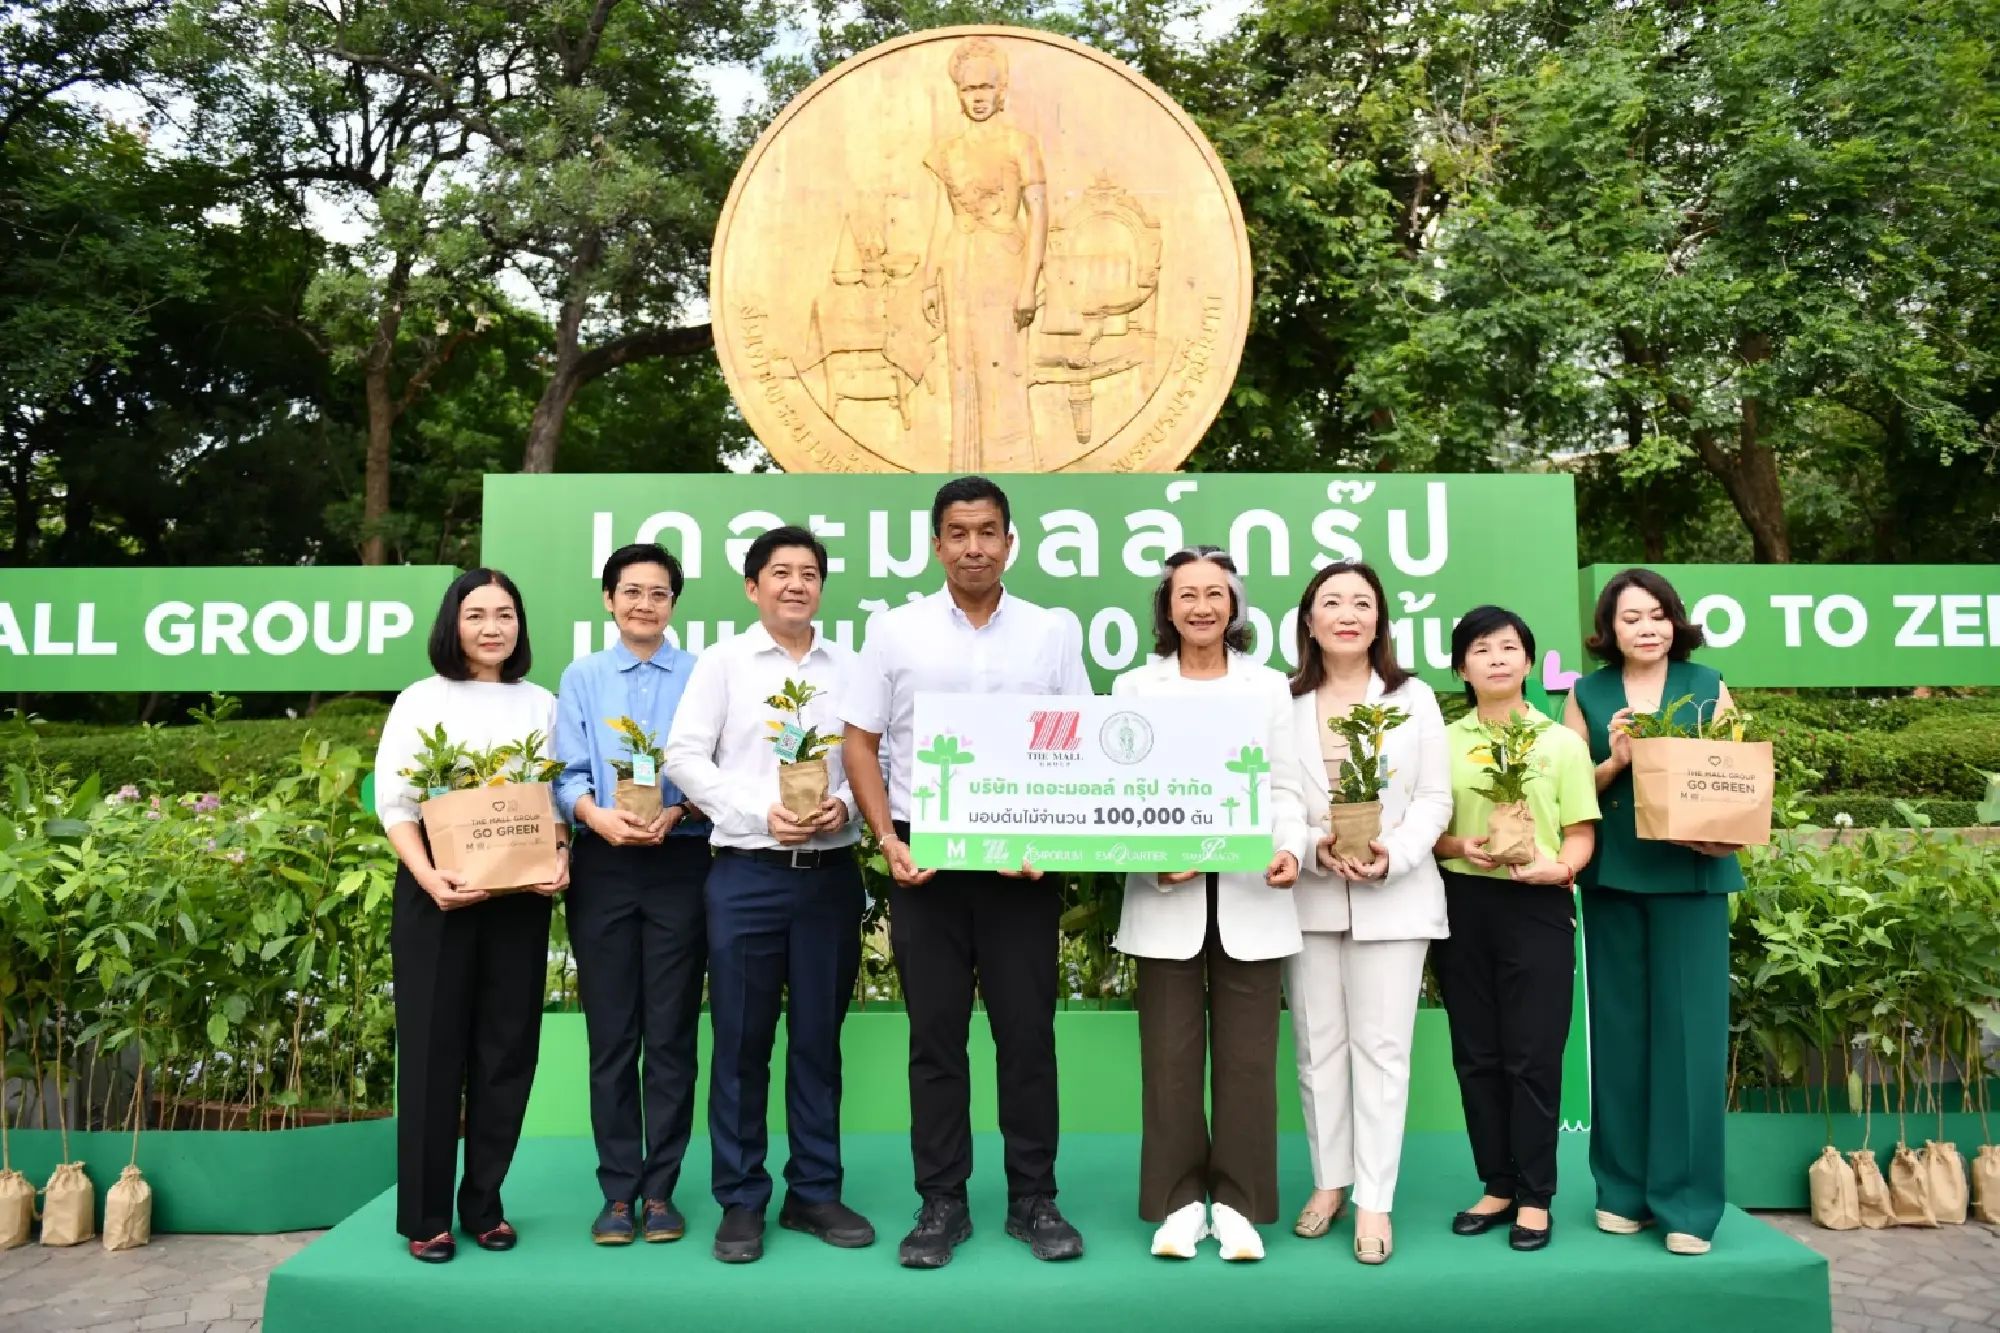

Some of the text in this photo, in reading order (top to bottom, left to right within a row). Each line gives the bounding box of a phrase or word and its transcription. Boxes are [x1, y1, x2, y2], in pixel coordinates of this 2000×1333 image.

[144, 600, 415, 656] GROUP
[1770, 594, 1868, 648] TO
[969, 777, 1213, 802] บริษัท เดอะมอลล์ กรุ๊ป จำกัด
[1687, 780, 1755, 793] GO GREEN
[969, 807, 1213, 828] มอบต้นไม้จำนวน 100,000 ต้น
[472, 823, 540, 838] GO GREEN
